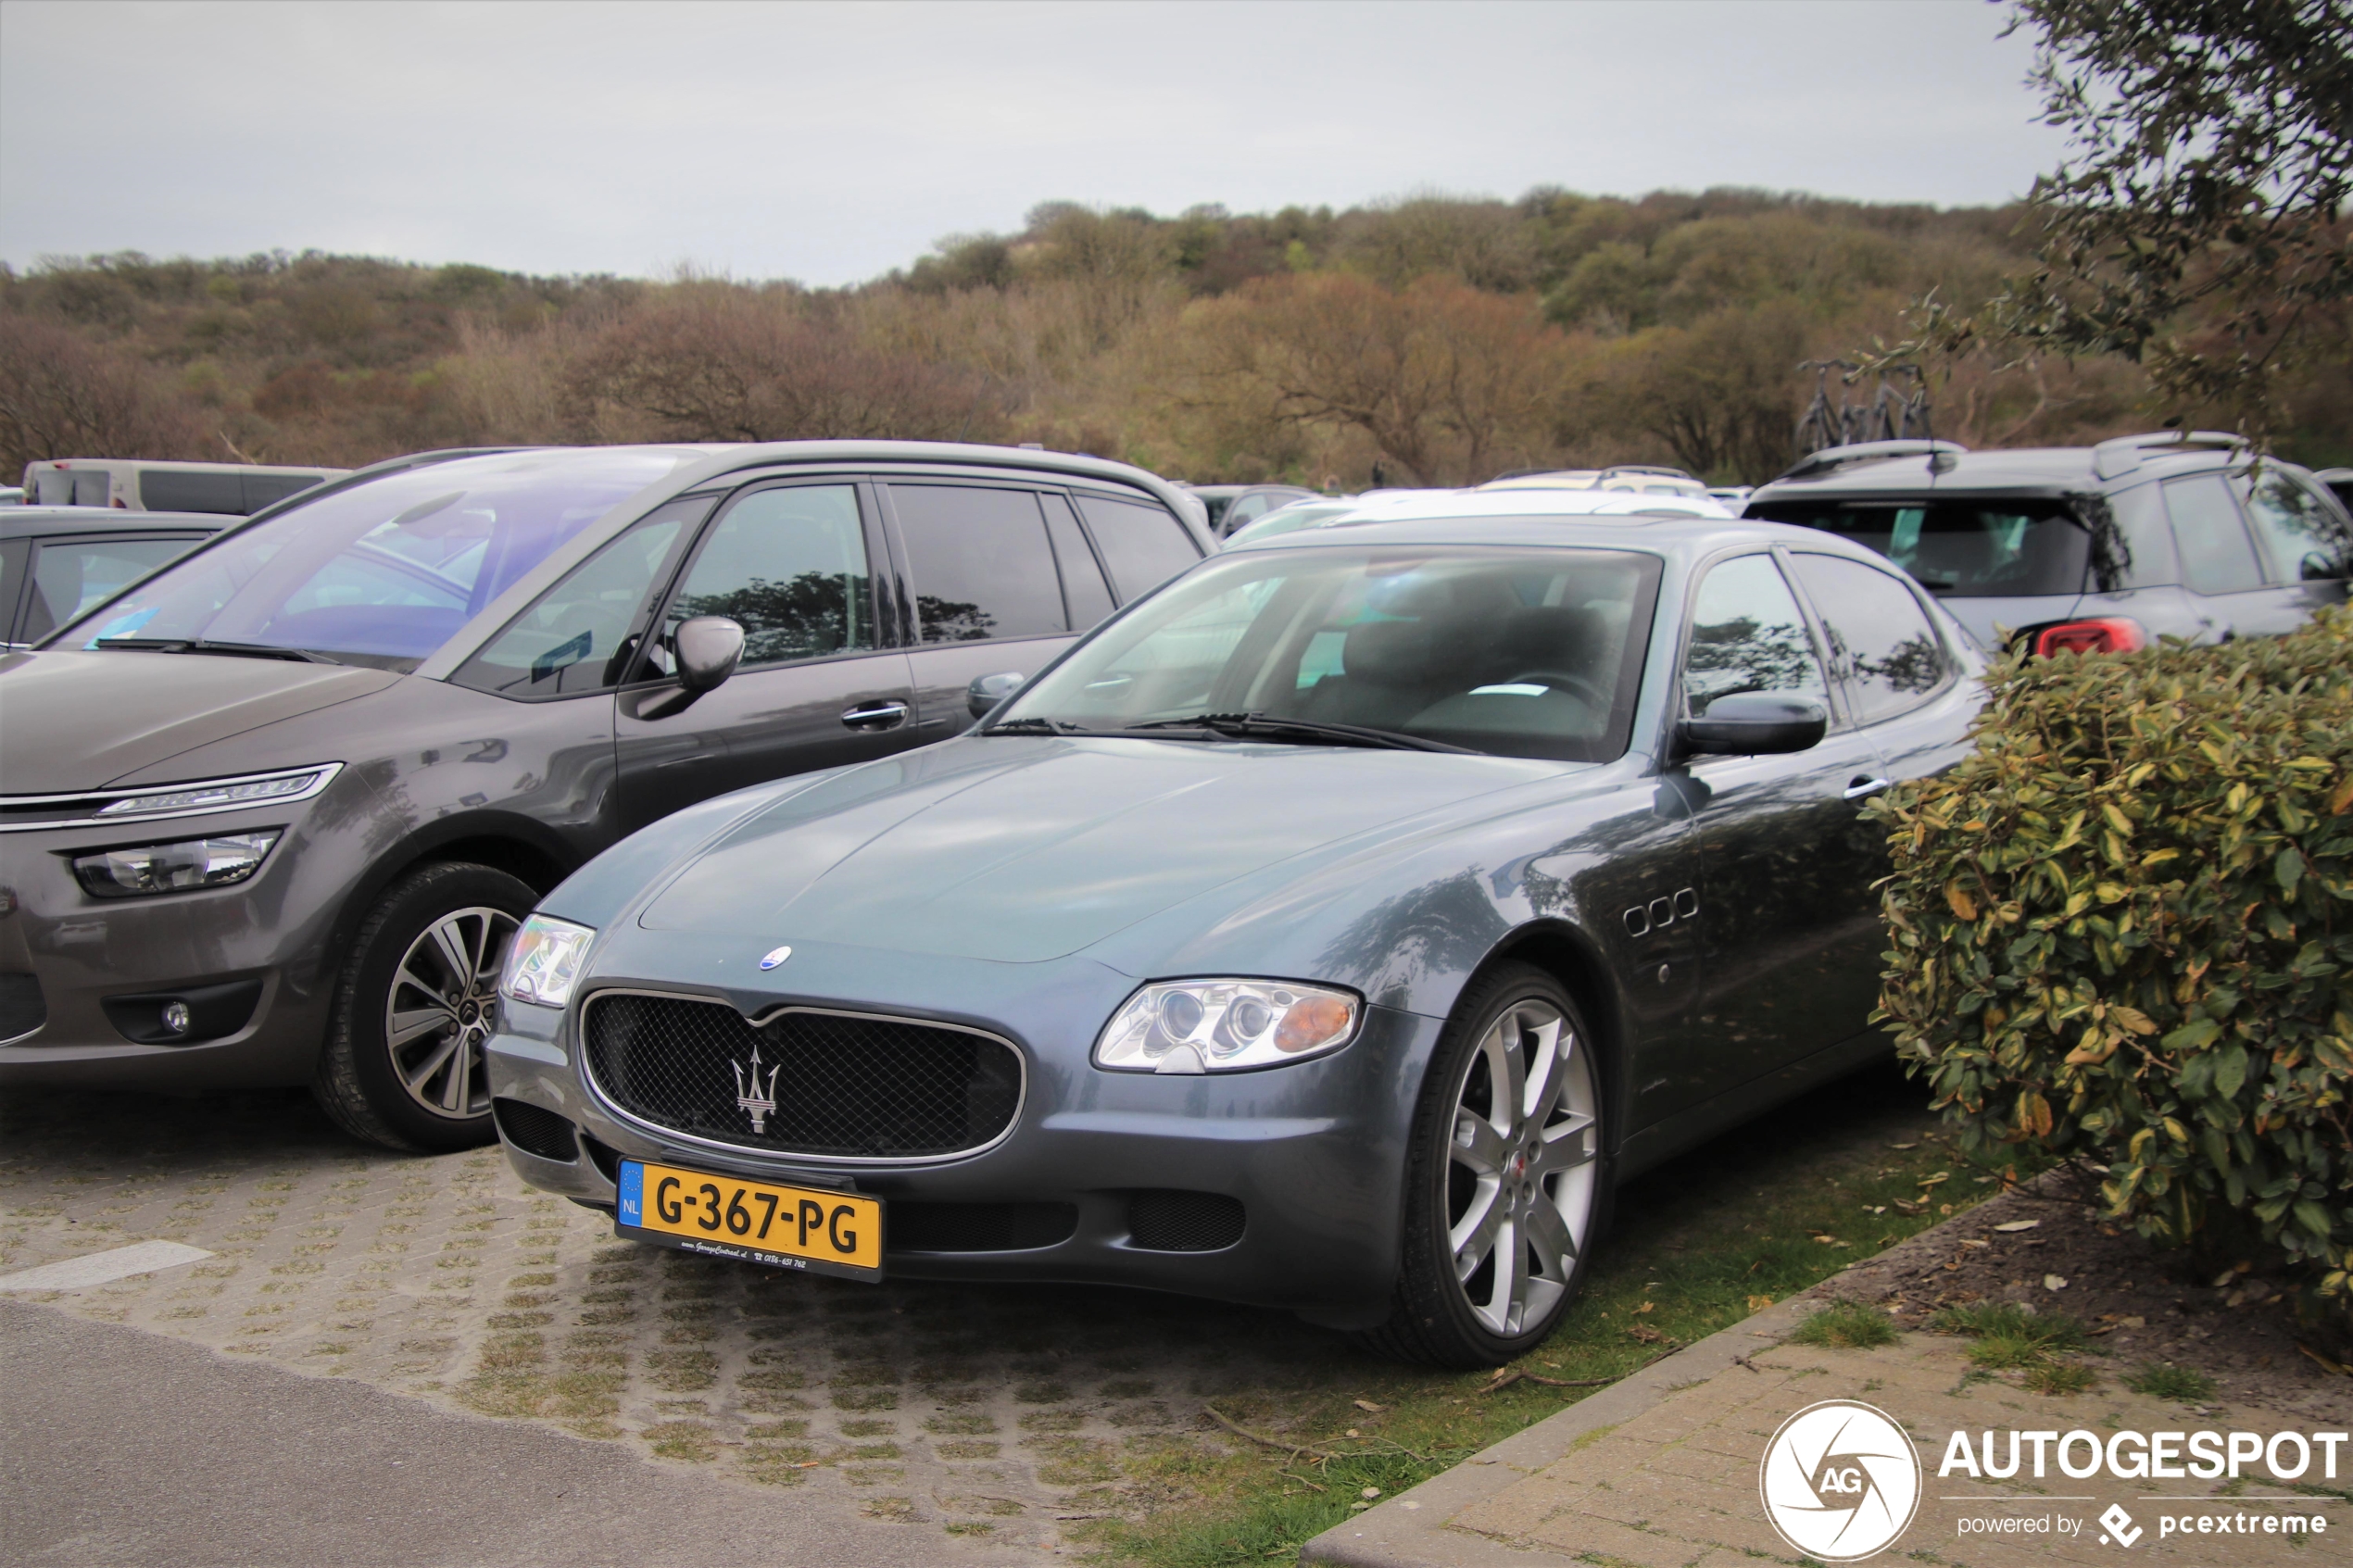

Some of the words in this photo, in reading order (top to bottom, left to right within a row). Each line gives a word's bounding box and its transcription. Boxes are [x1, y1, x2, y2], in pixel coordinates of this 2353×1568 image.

[623, 1199, 639, 1214] NL
[657, 1176, 857, 1254] G-367-PG
[794, 1259, 806, 1269] 762
